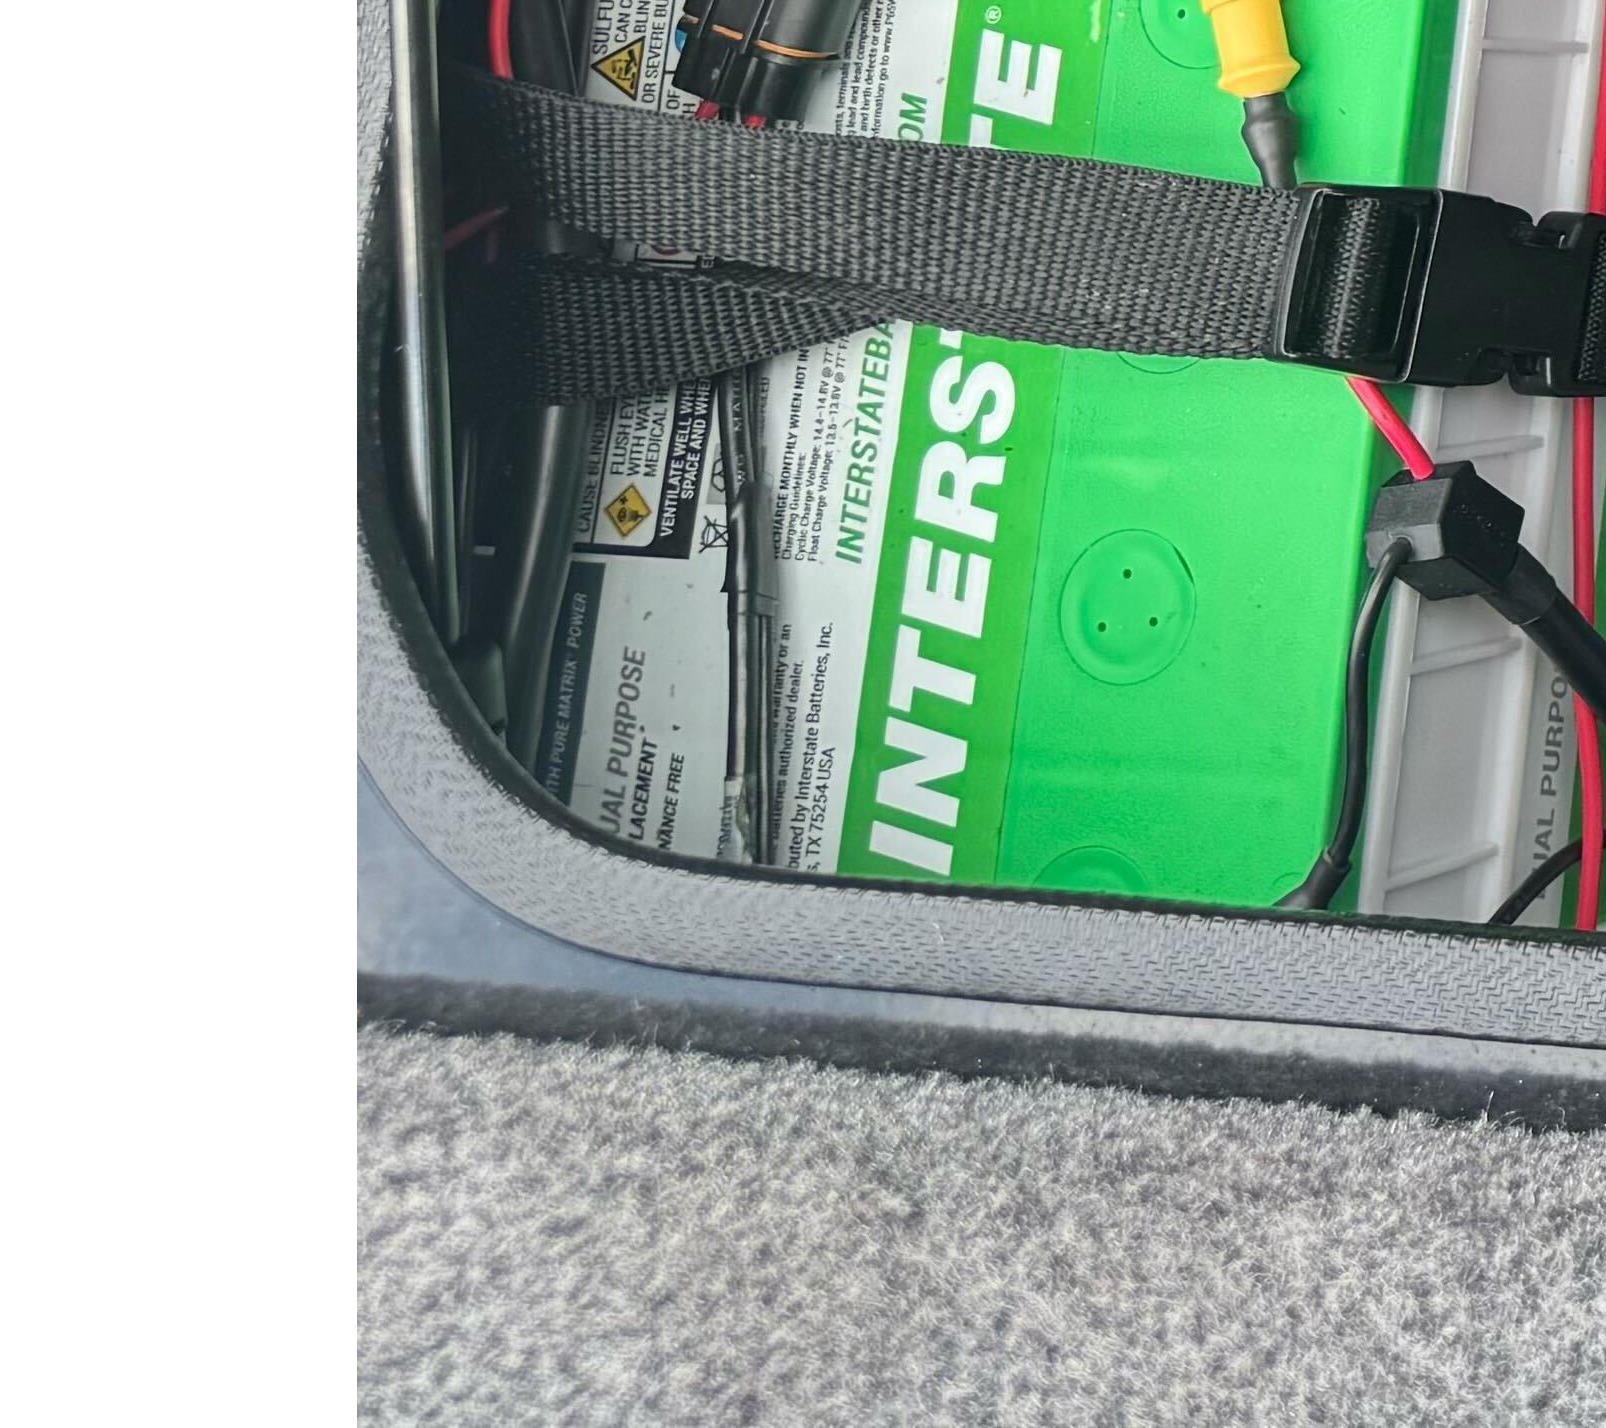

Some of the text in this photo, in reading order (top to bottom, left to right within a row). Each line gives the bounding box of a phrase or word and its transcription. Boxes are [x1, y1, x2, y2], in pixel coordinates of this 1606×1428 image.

[615, 11, 631, 43] CAN
[645, 22, 666, 78] SEVERE
[641, 81, 656, 104] OR
[610, 424, 631, 475] FLUSH
[627, 434, 645, 476] WITH
[643, 407, 667, 477] MEDICAL
[681, 419, 706, 500] SPACE AND
[778, 365, 806, 490] MONTHLY WHEN NOT
[660, 418, 692, 537] VENTILATE WELL
[812, 494, 828, 531] Charge
[808, 534, 823, 562] Float
[550, 721, 570, 763] PURE
[566, 591, 587, 648] POWER
[599, 646, 646, 834] UAL PURPOSE
[777, 704, 797, 776] authorized
[792, 622, 834, 822] by Interstate Batteries, Inc.
[666, 752, 684, 793] FREE
[806, 746, 836, 856] TX 75254 USA
